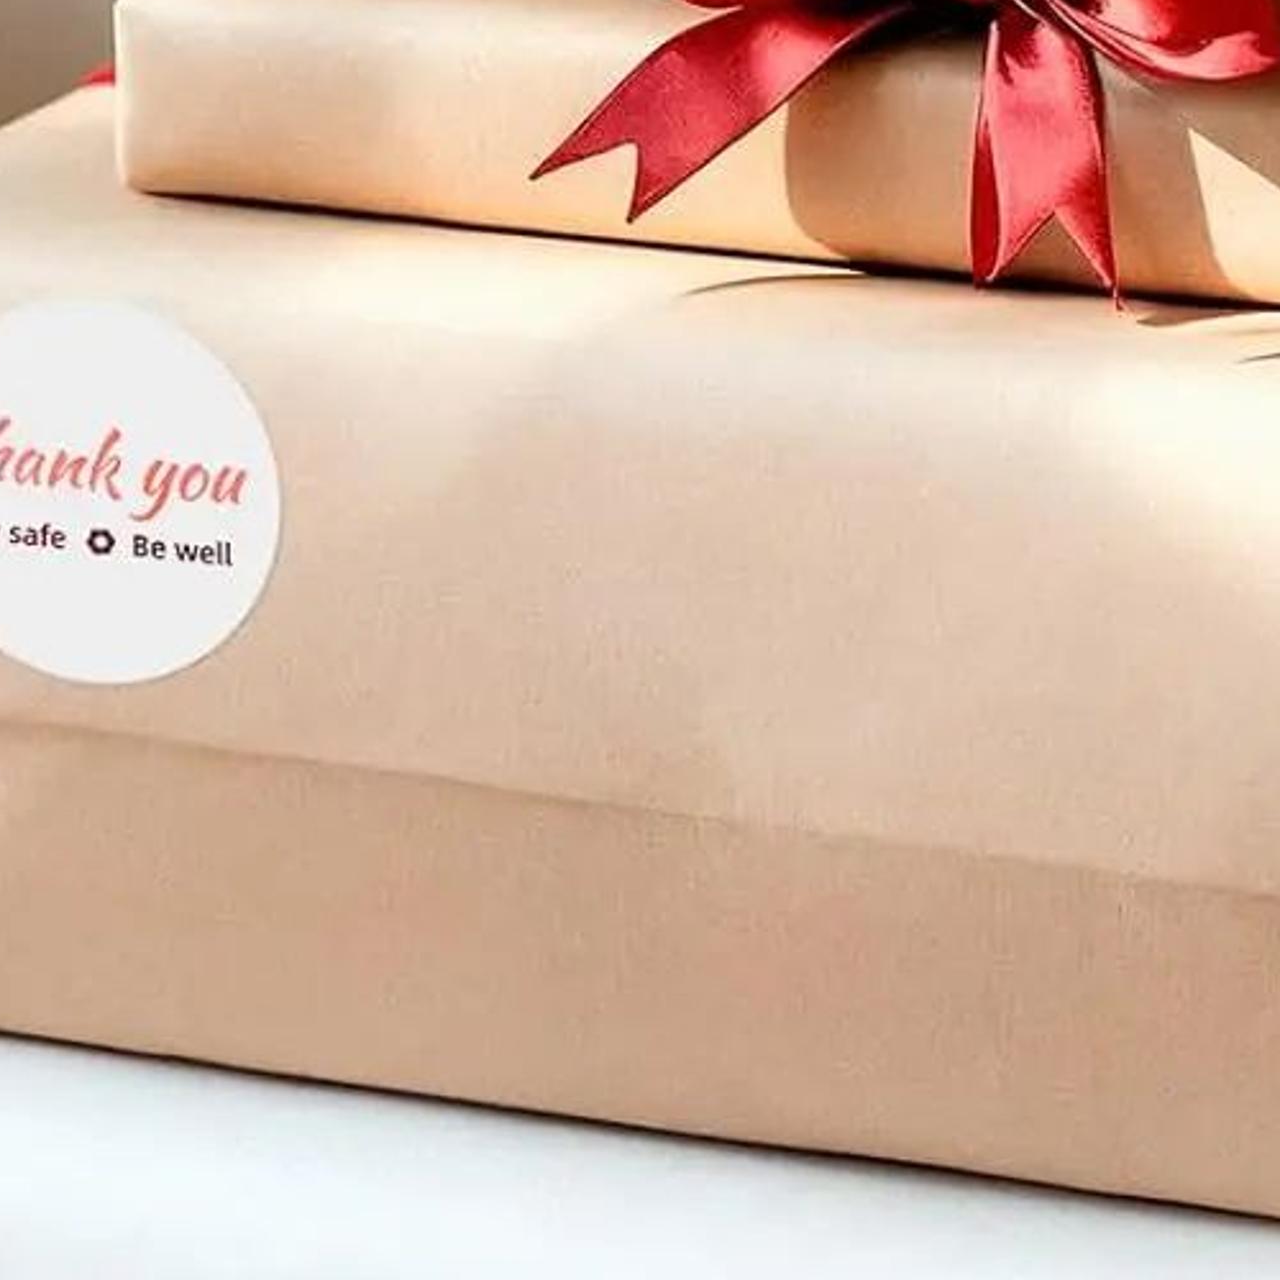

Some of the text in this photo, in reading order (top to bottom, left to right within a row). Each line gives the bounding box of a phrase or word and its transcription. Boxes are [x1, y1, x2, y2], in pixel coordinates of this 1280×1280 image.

[130, 458, 250, 523] you
[9, 523, 67, 549] safe
[133, 535, 166, 559] Be
[175, 540, 235, 566] well
